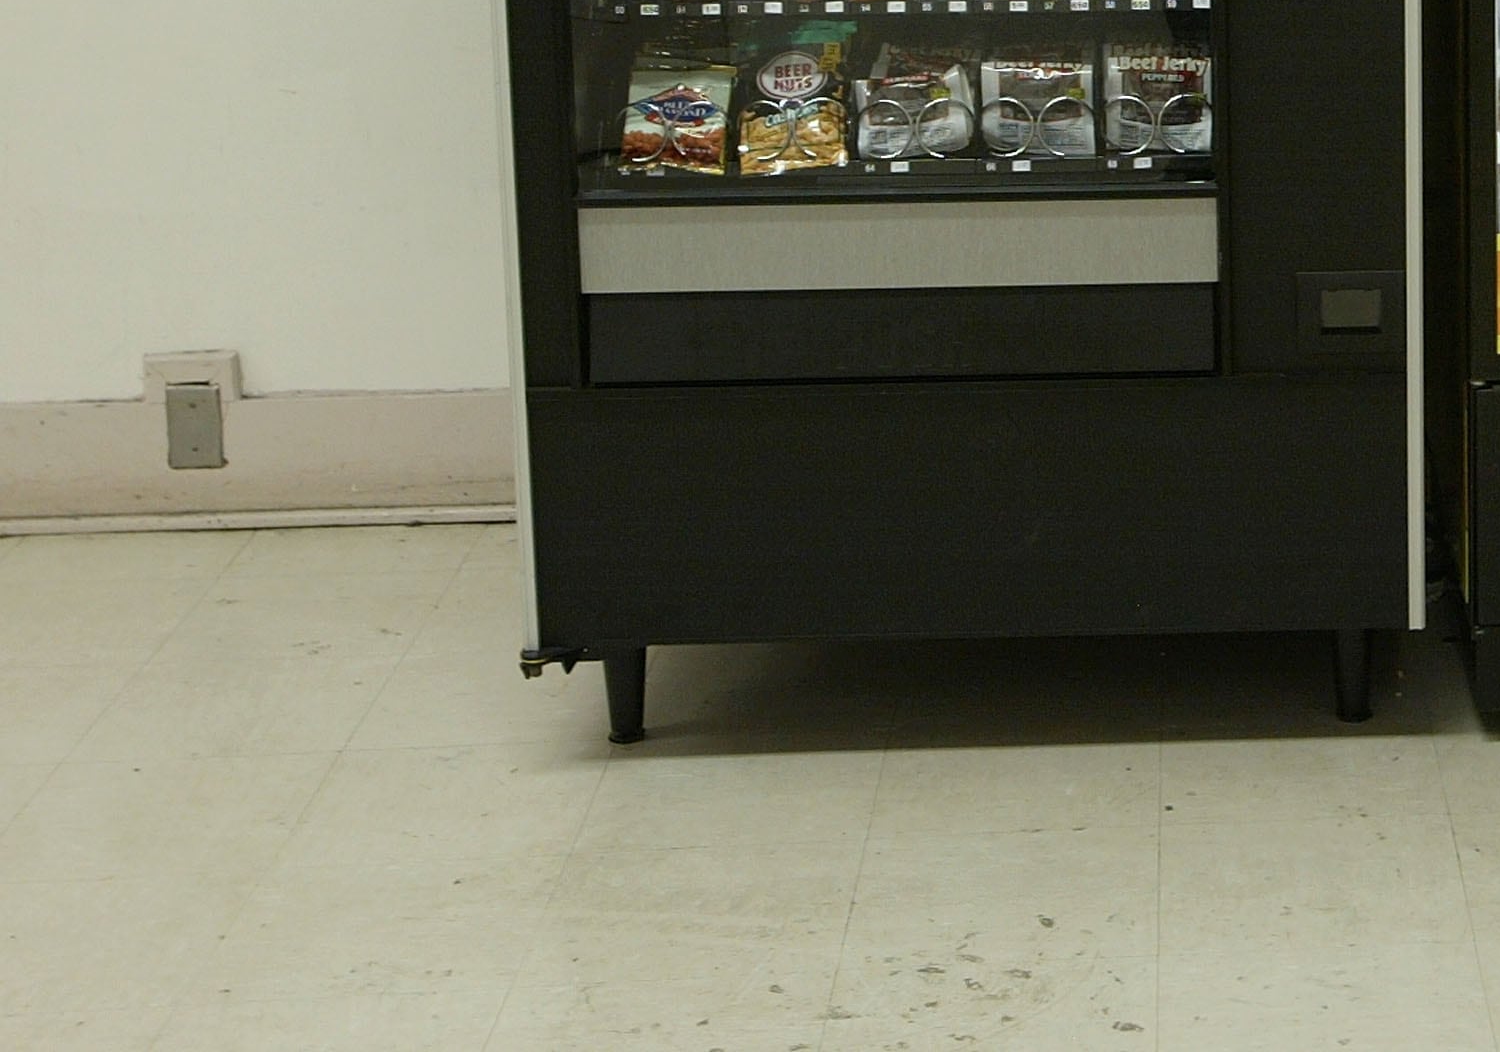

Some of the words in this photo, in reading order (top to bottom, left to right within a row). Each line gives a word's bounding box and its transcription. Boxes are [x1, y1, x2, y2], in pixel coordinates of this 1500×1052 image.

[774, 63, 813, 79] BEER
[1119, 55, 1158, 70] Beef
[1160, 55, 1210, 77] Jerky
[773, 77, 814, 92] NUTS
